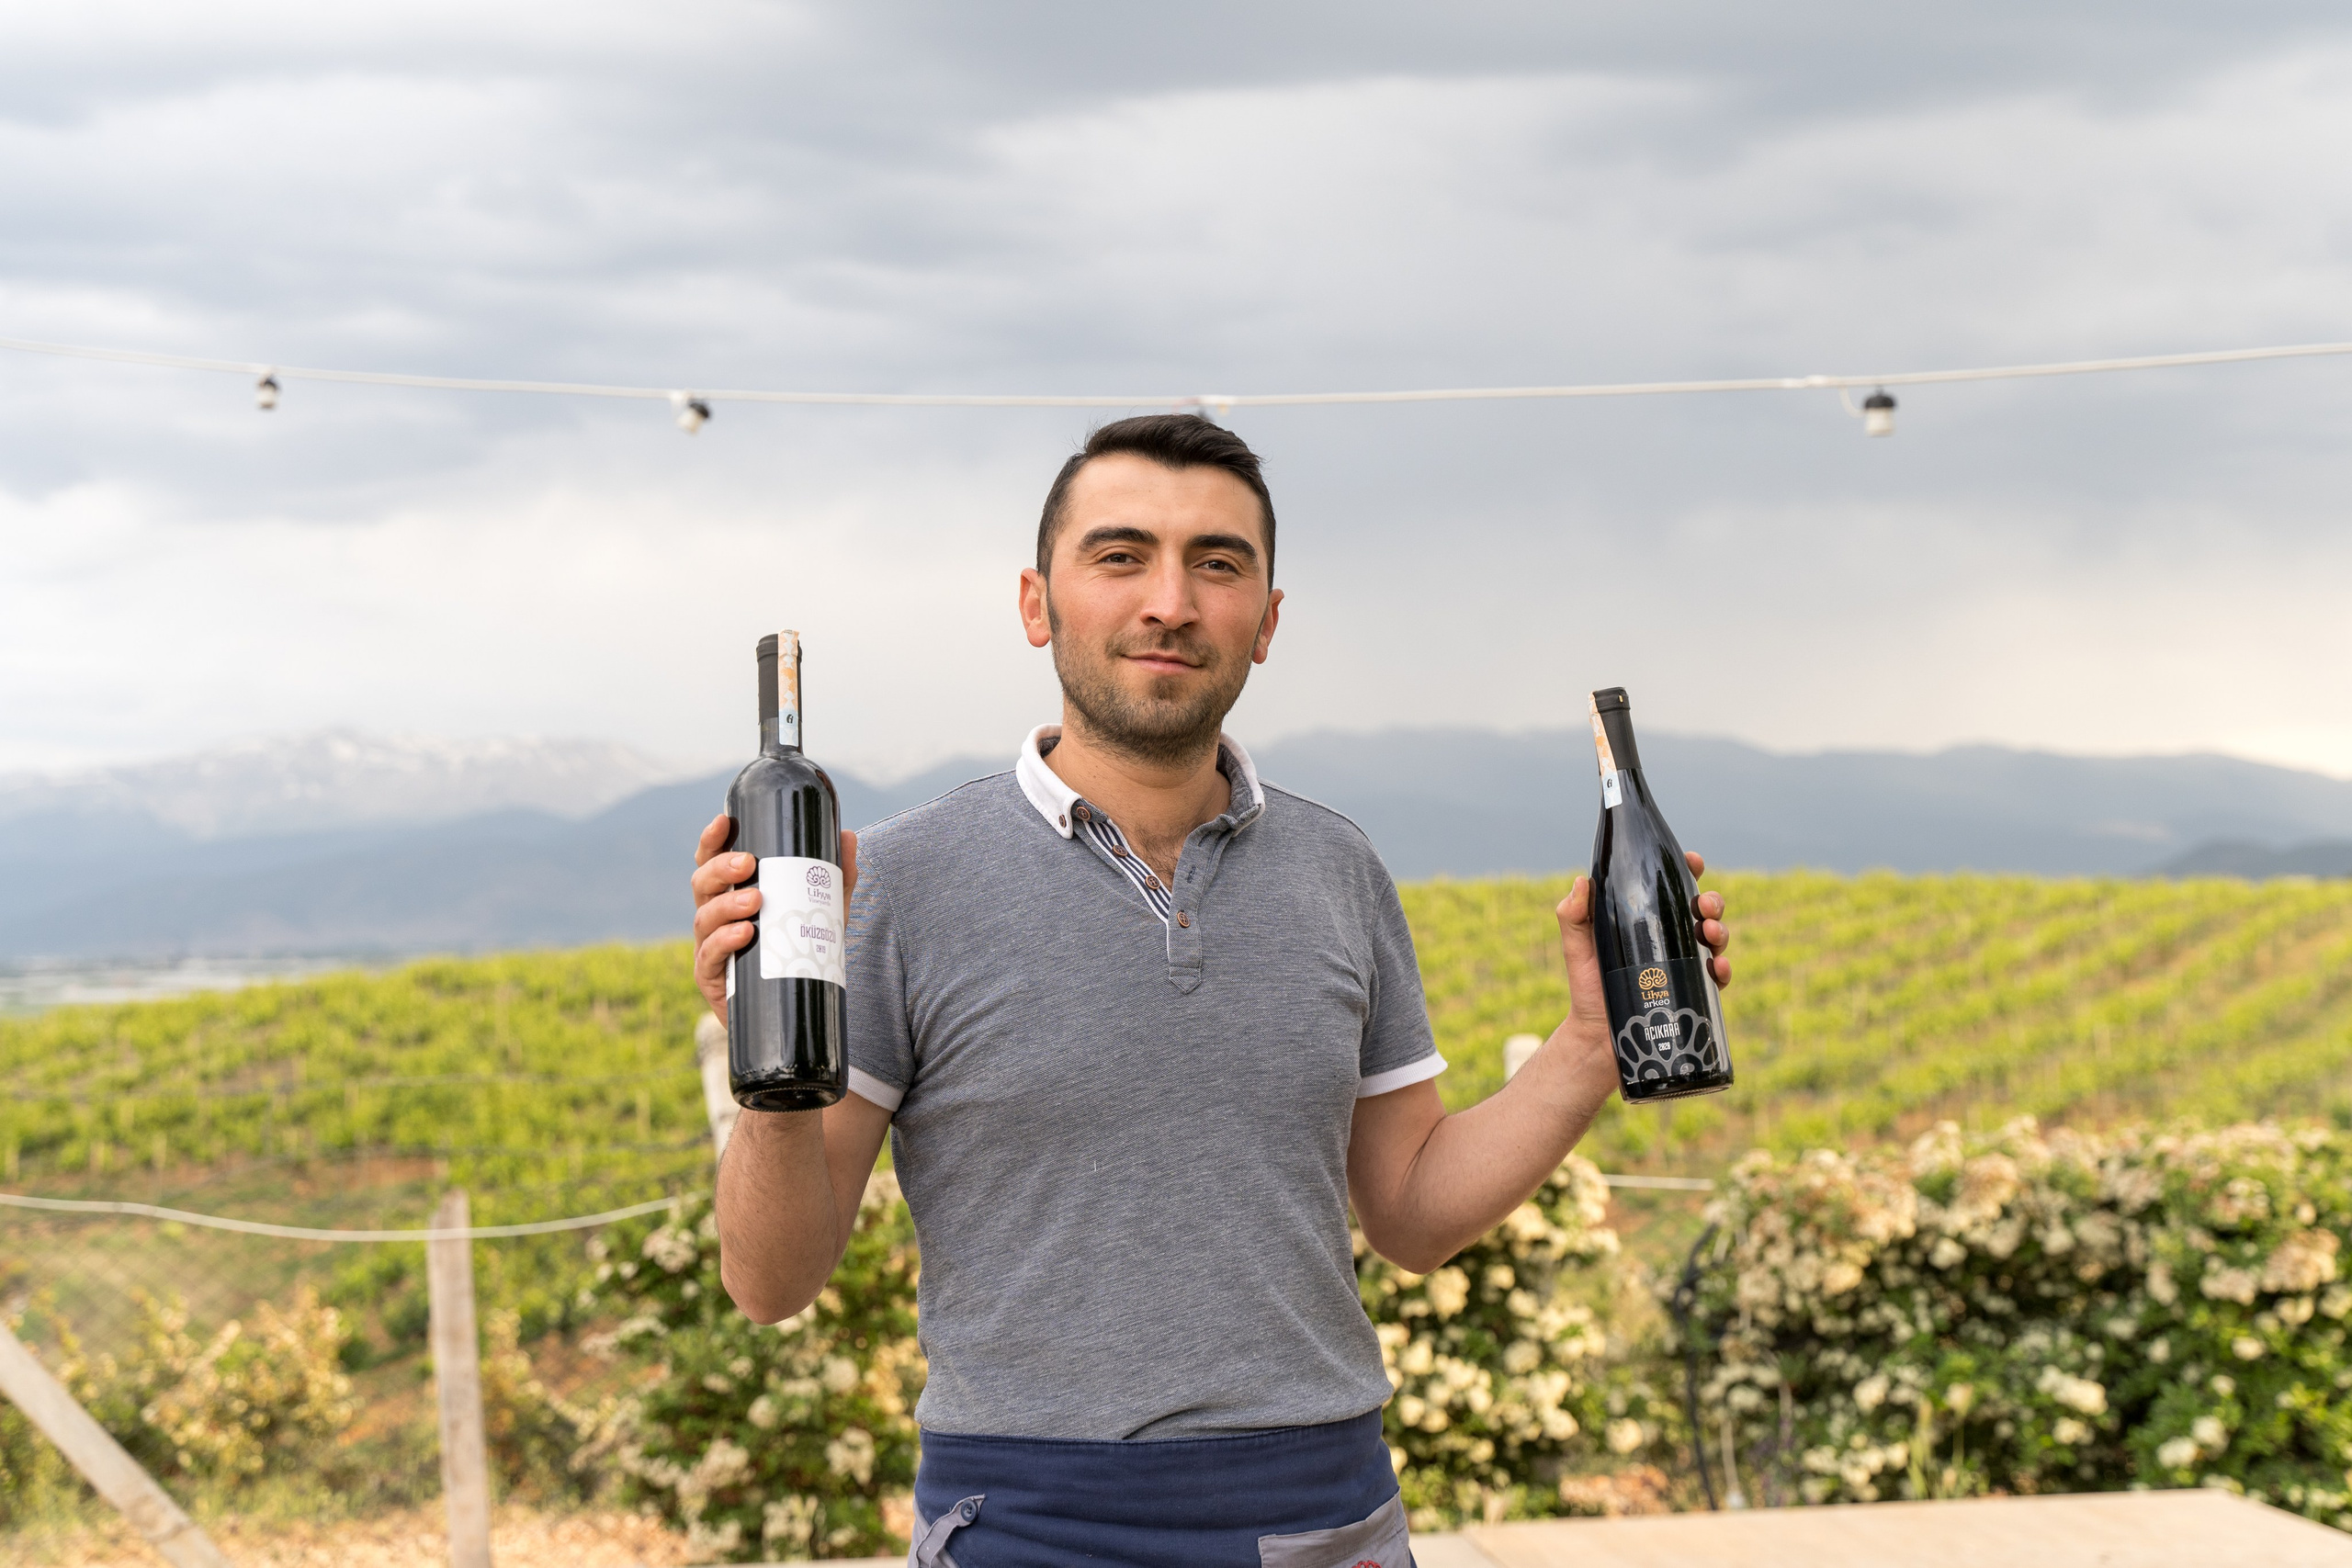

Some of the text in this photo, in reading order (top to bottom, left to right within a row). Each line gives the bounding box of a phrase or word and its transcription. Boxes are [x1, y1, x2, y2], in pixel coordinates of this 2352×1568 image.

[807, 887, 831, 900] Likya
[1641, 990, 1669, 1000] Likya
[1644, 998, 1670, 1009] arkeo
[1644, 1021, 1680, 1041] ACIKARA
